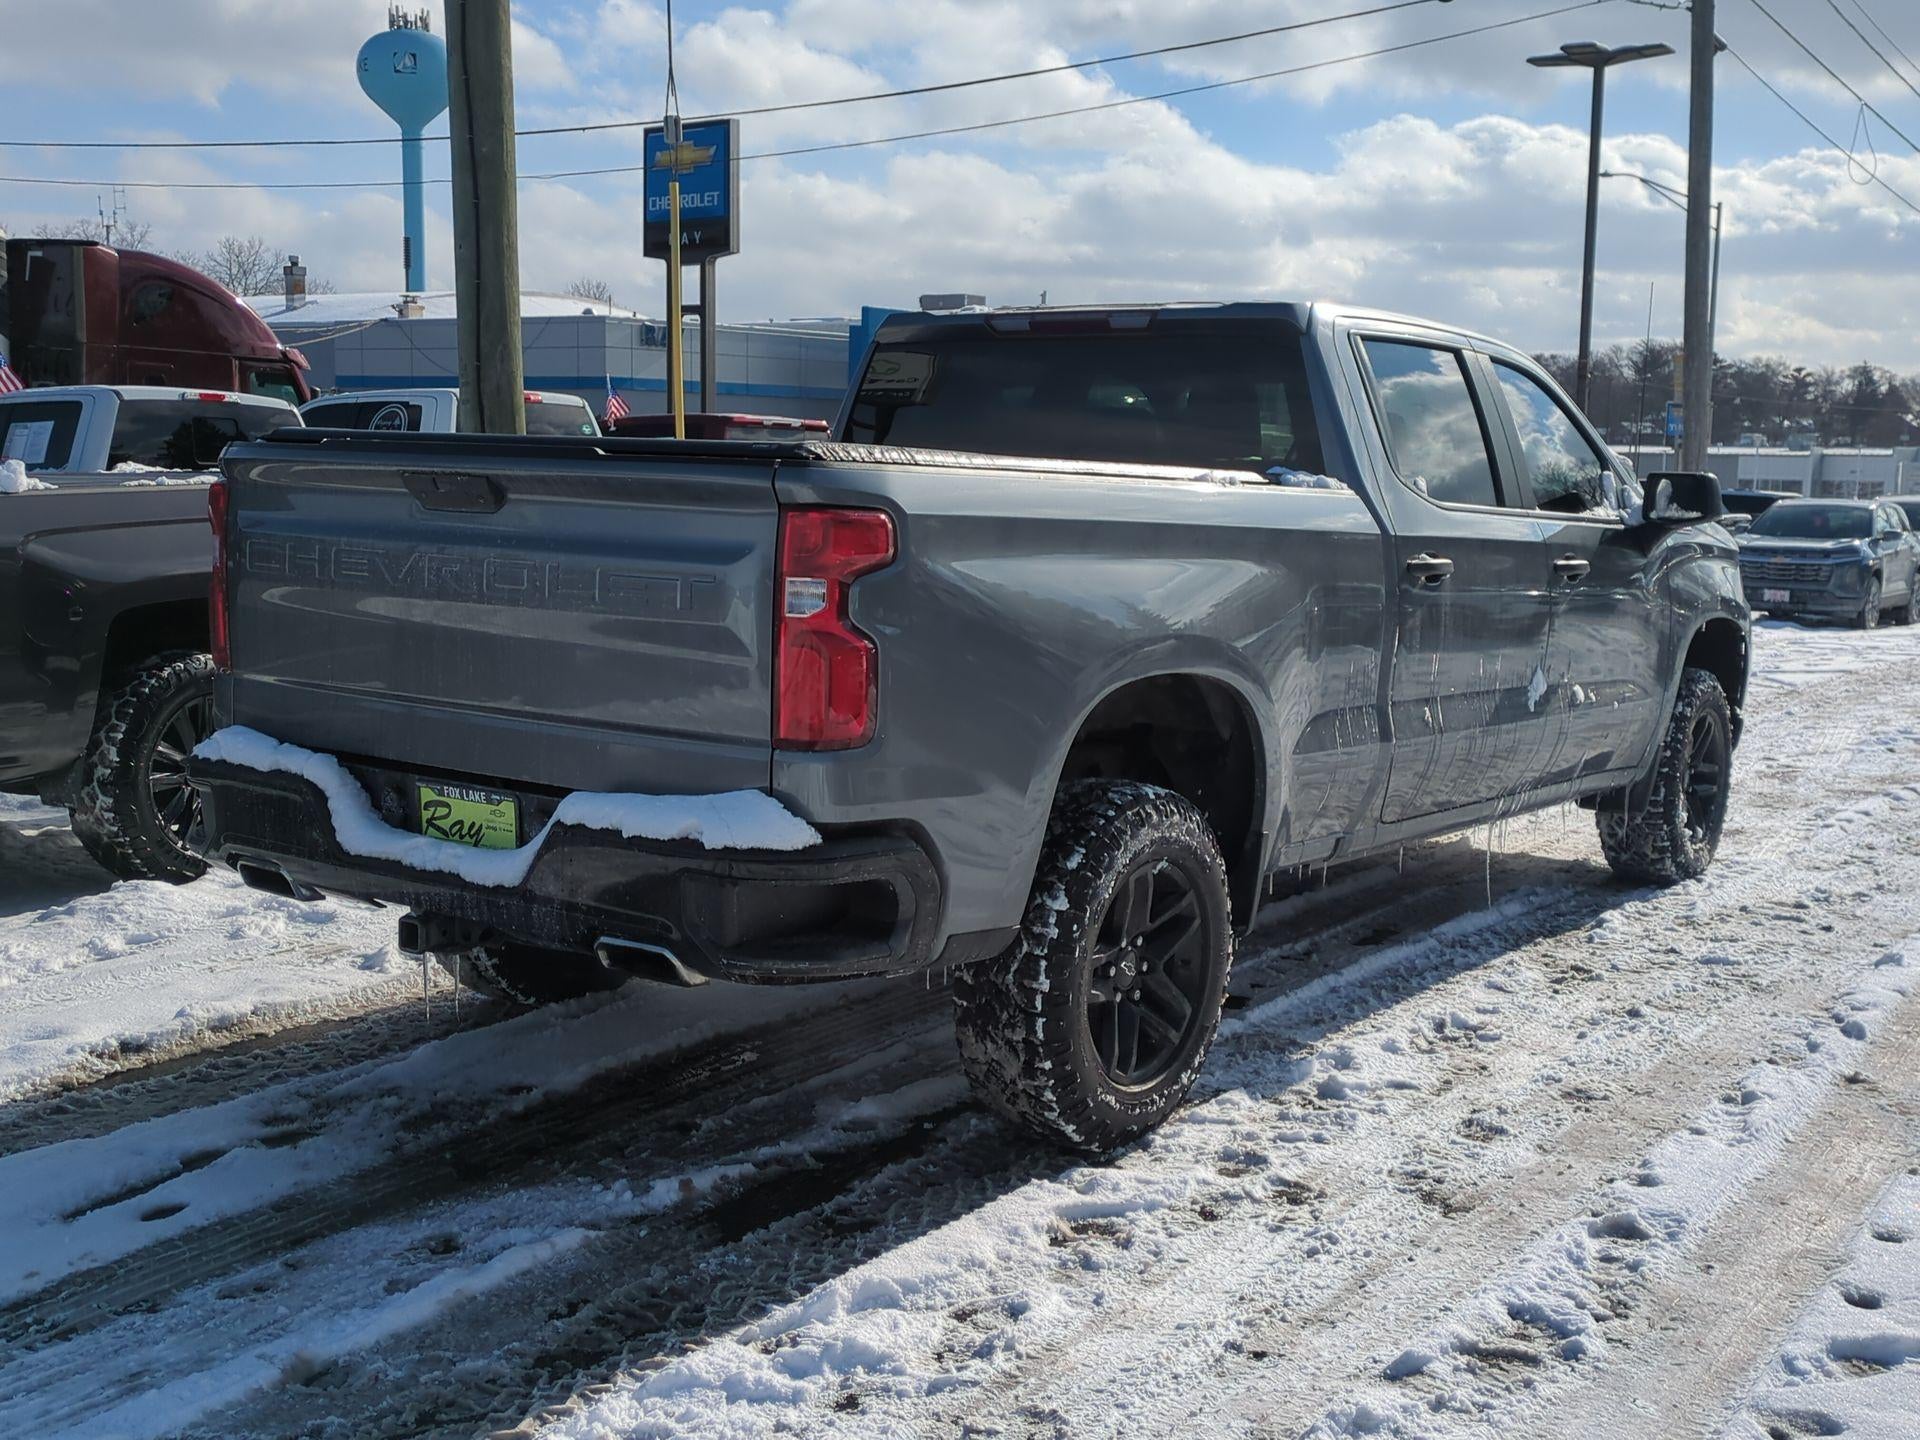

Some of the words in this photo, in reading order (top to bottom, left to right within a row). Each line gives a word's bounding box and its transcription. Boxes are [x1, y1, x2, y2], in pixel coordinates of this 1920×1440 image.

[649, 191, 720, 211] CHEROLET
[668, 230, 702, 245] AY
[245, 538, 718, 611] CHEVROLET
[443, 785, 461, 800] FOX
[464, 789, 487, 803] LAKE
[423, 799, 485, 847] Ray
